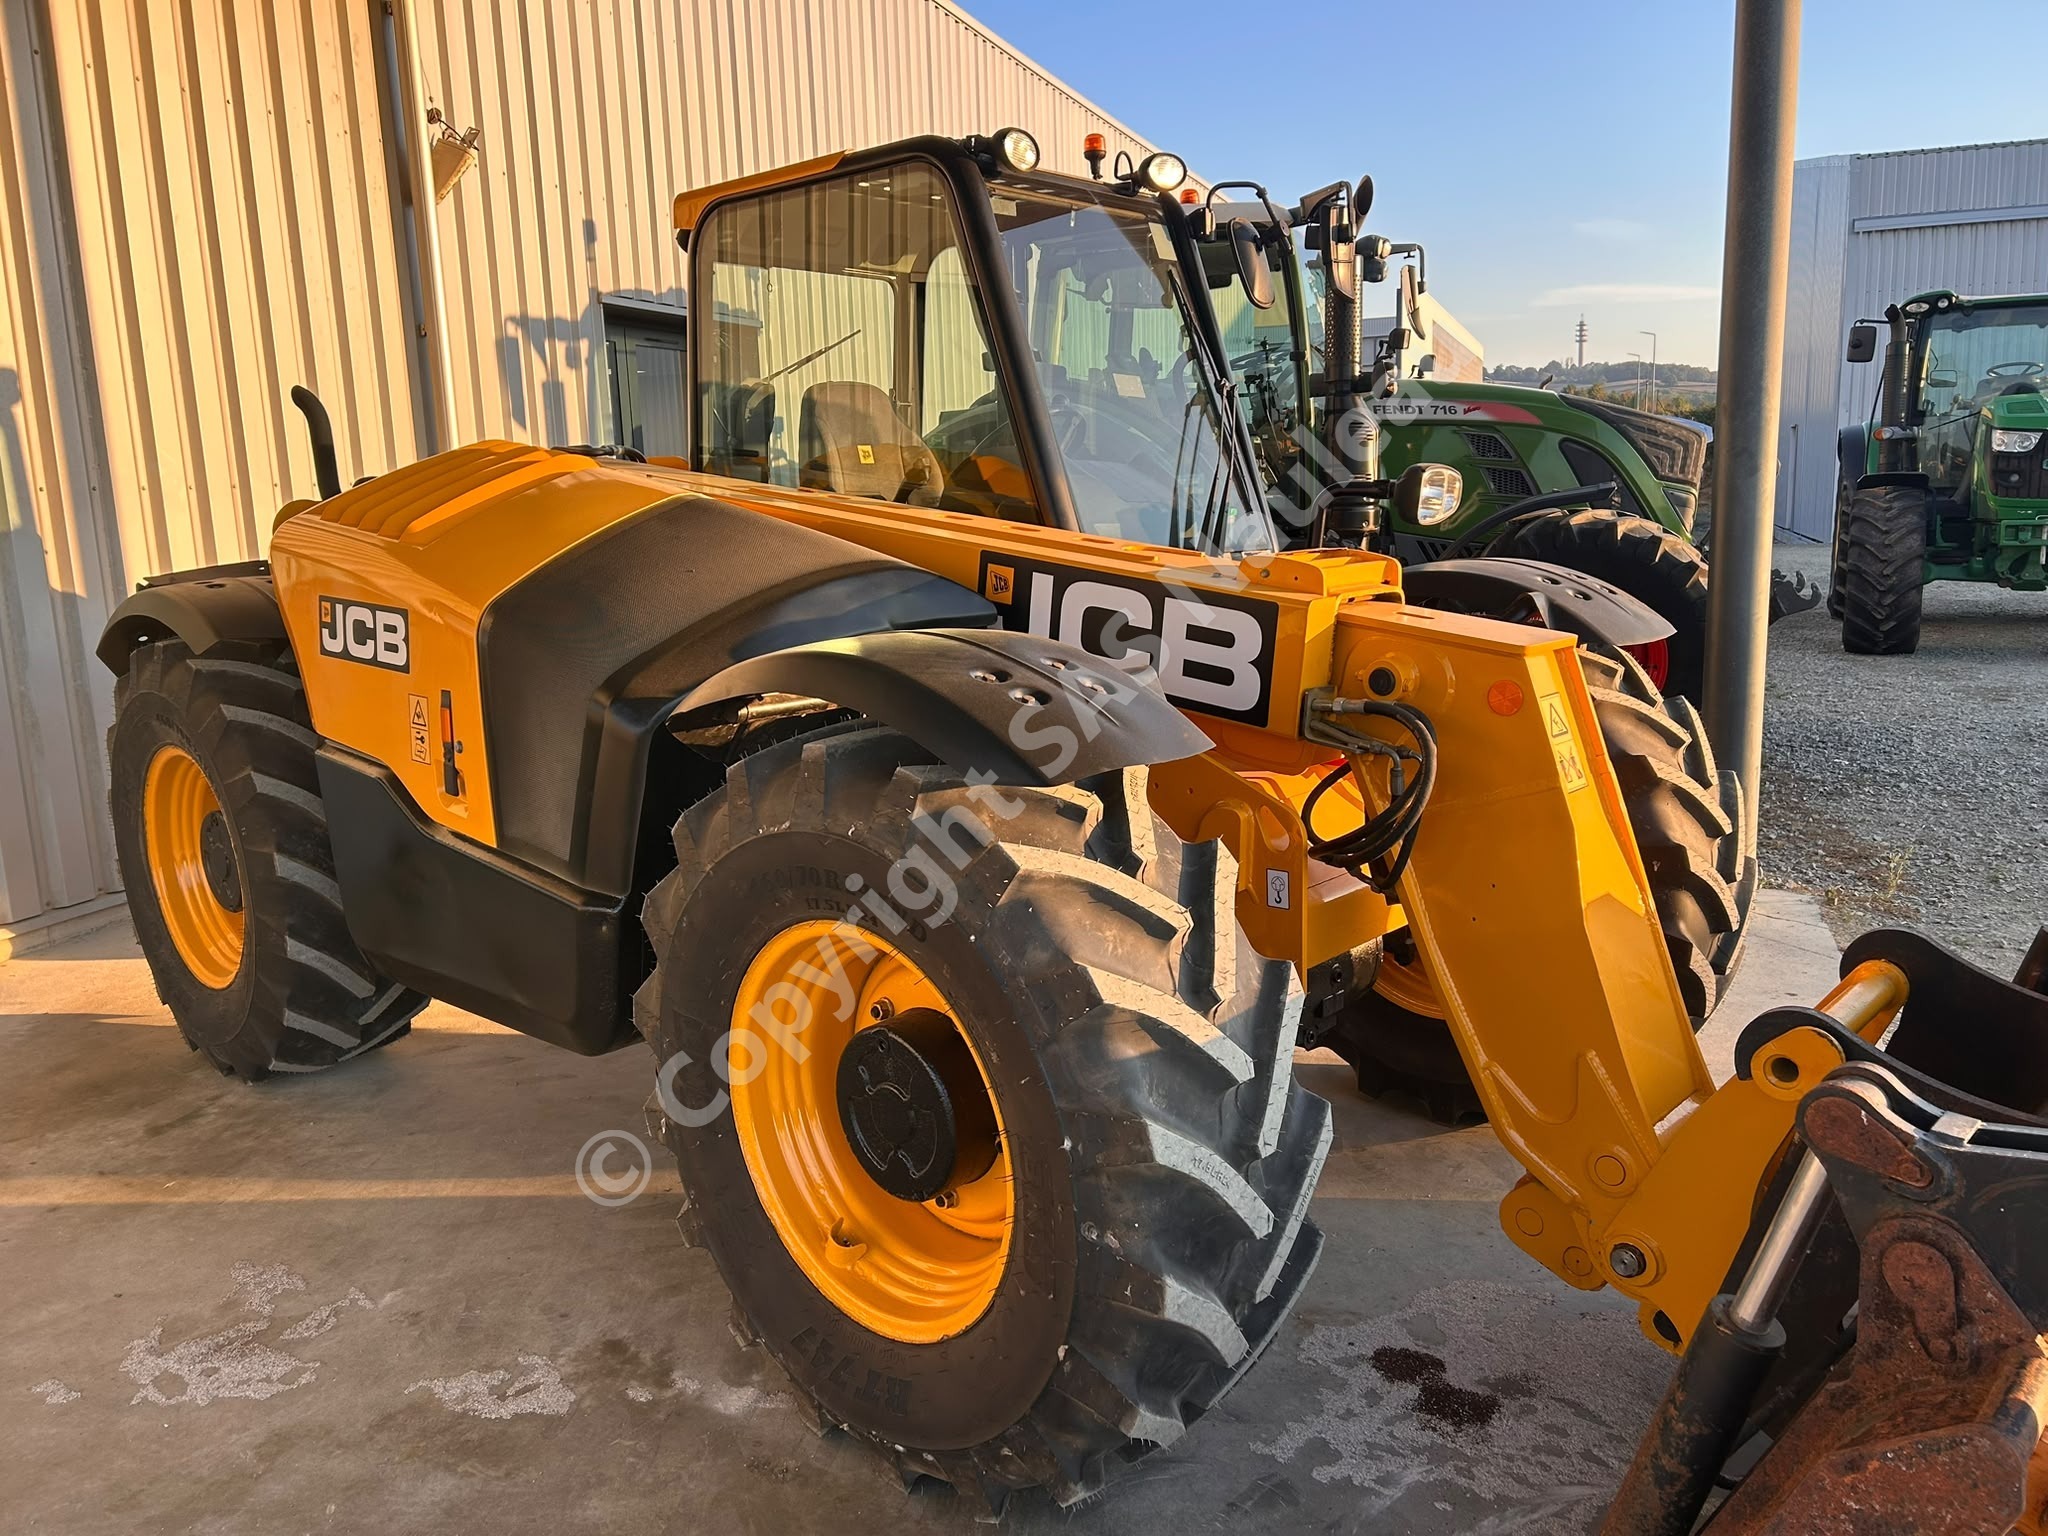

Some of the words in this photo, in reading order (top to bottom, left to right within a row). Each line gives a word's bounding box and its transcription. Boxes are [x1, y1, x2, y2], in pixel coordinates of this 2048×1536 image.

[1373, 404, 1425, 416] FENDT
[1430, 405, 1458, 416] 716
[992, 573, 1009, 592] JCB
[321, 603, 408, 666] JCB
[988, 572, 1263, 712] JCB
